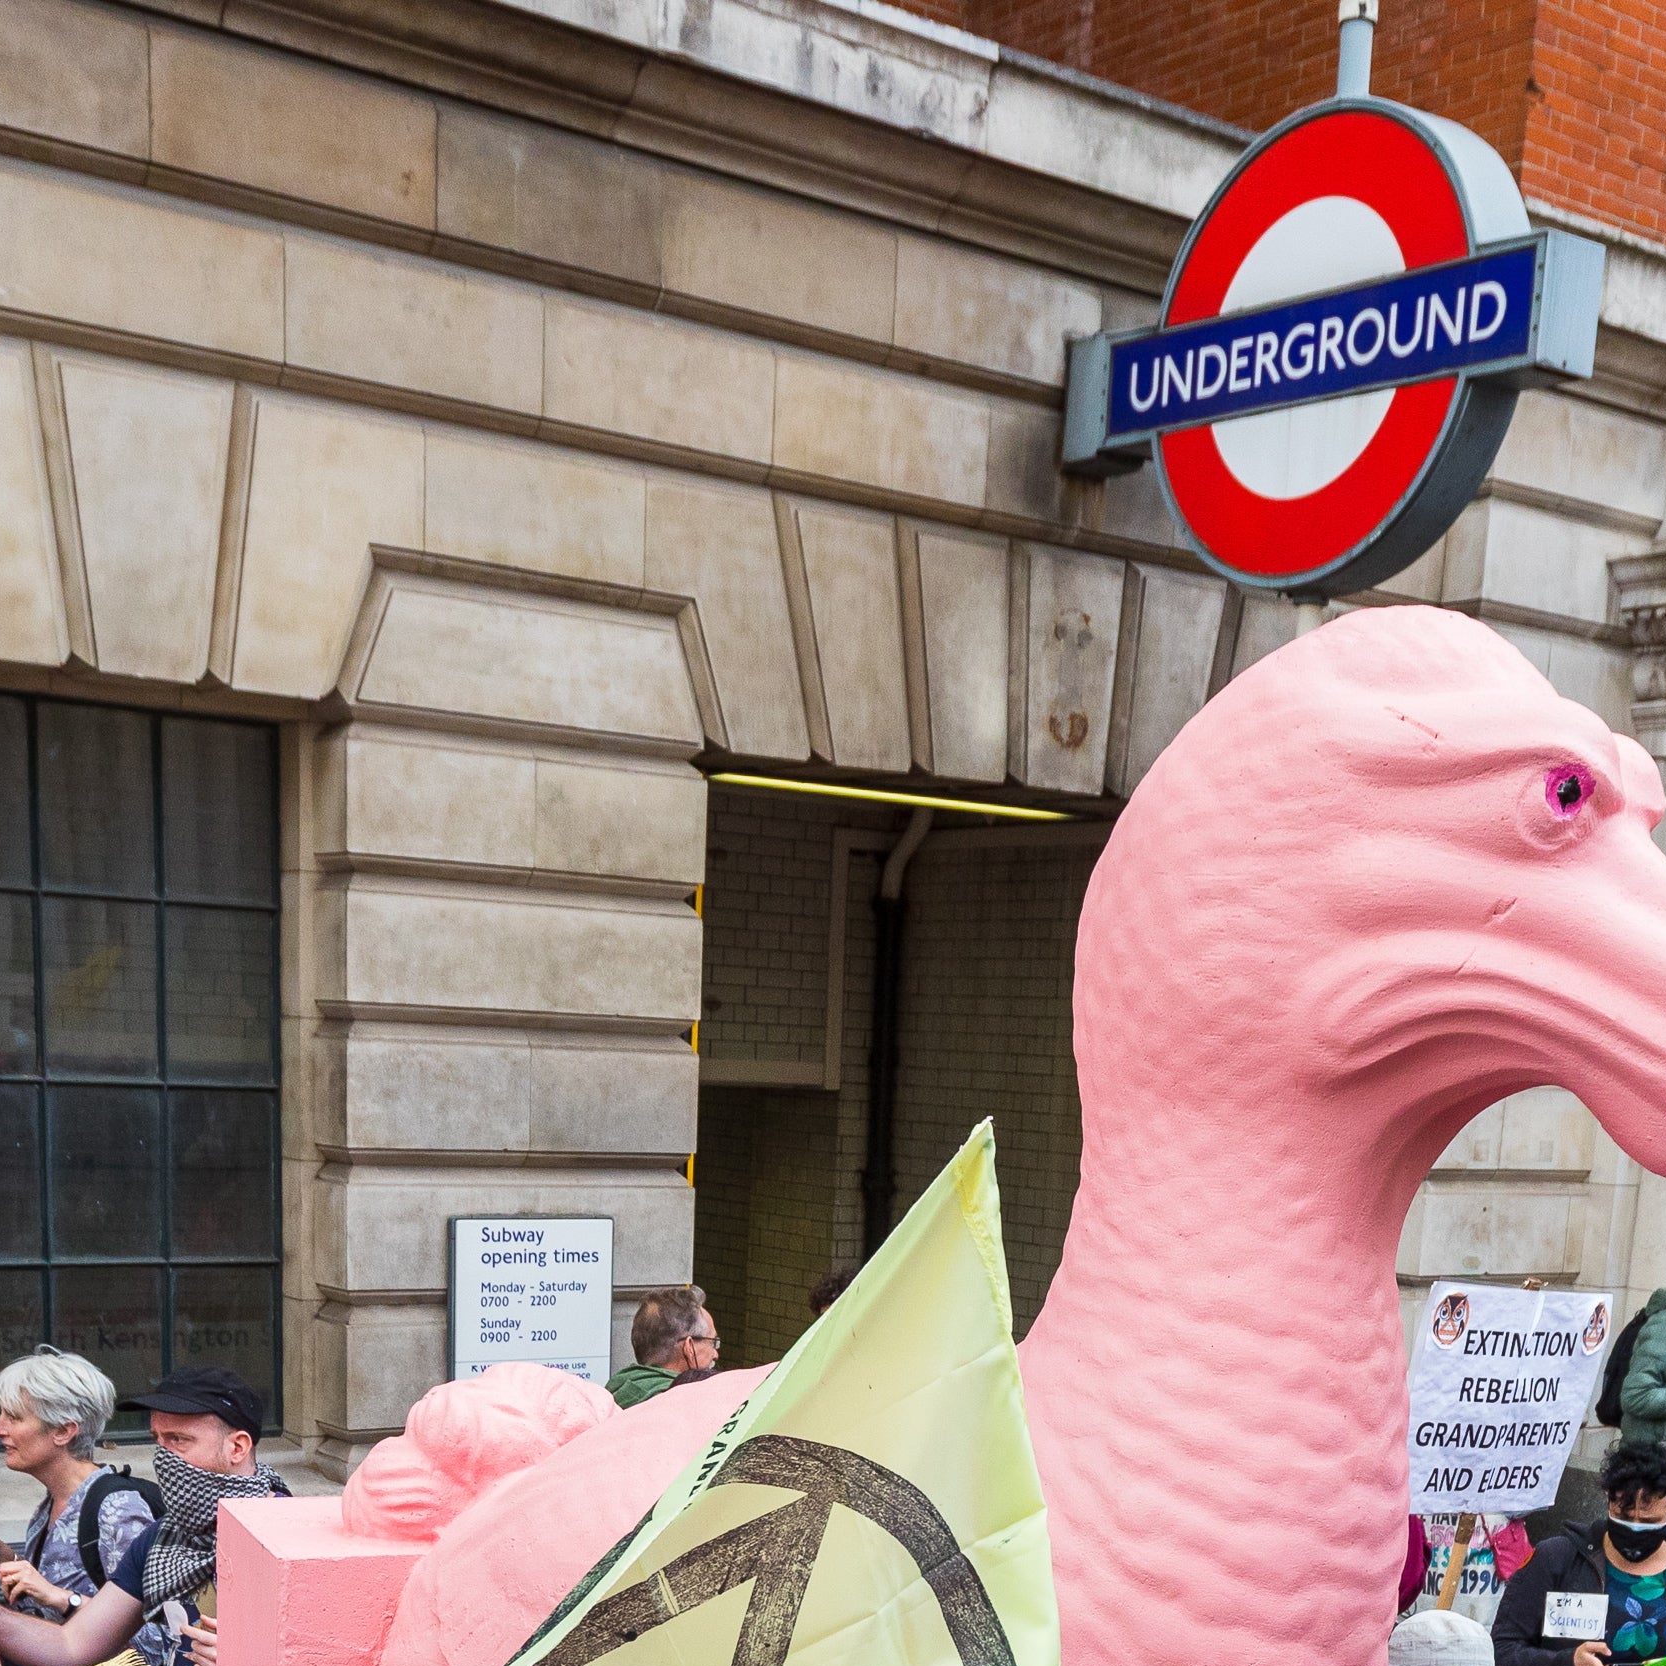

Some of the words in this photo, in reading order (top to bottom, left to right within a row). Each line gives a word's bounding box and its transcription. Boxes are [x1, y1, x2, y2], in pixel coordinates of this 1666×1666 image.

[1129, 280, 1507, 413] UNDERGROUND
[481, 1227, 545, 1246] Subway
[481, 1249, 547, 1268] opening
[553, 1248, 600, 1264] times
[481, 1282, 526, 1295] Monday
[539, 1281, 587, 1294] Saturday
[480, 1296, 509, 1308] 0700
[530, 1295, 557, 1306] 2200
[480, 1318, 521, 1330] Sunday
[480, 1331, 510, 1343] 0900
[531, 1330, 557, 1341] 2200
[572, 1361, 587, 1369] use
[1459, 1376, 1561, 1404] REBELLION
[1415, 1420, 1571, 1449] GRANDPARENTS
[1423, 1467, 1473, 1493] AND
[1477, 1465, 1542, 1493] ELDERS
[1577, 1598, 1583, 1607] A
[1549, 1611, 1600, 1631] SCIENTIST
